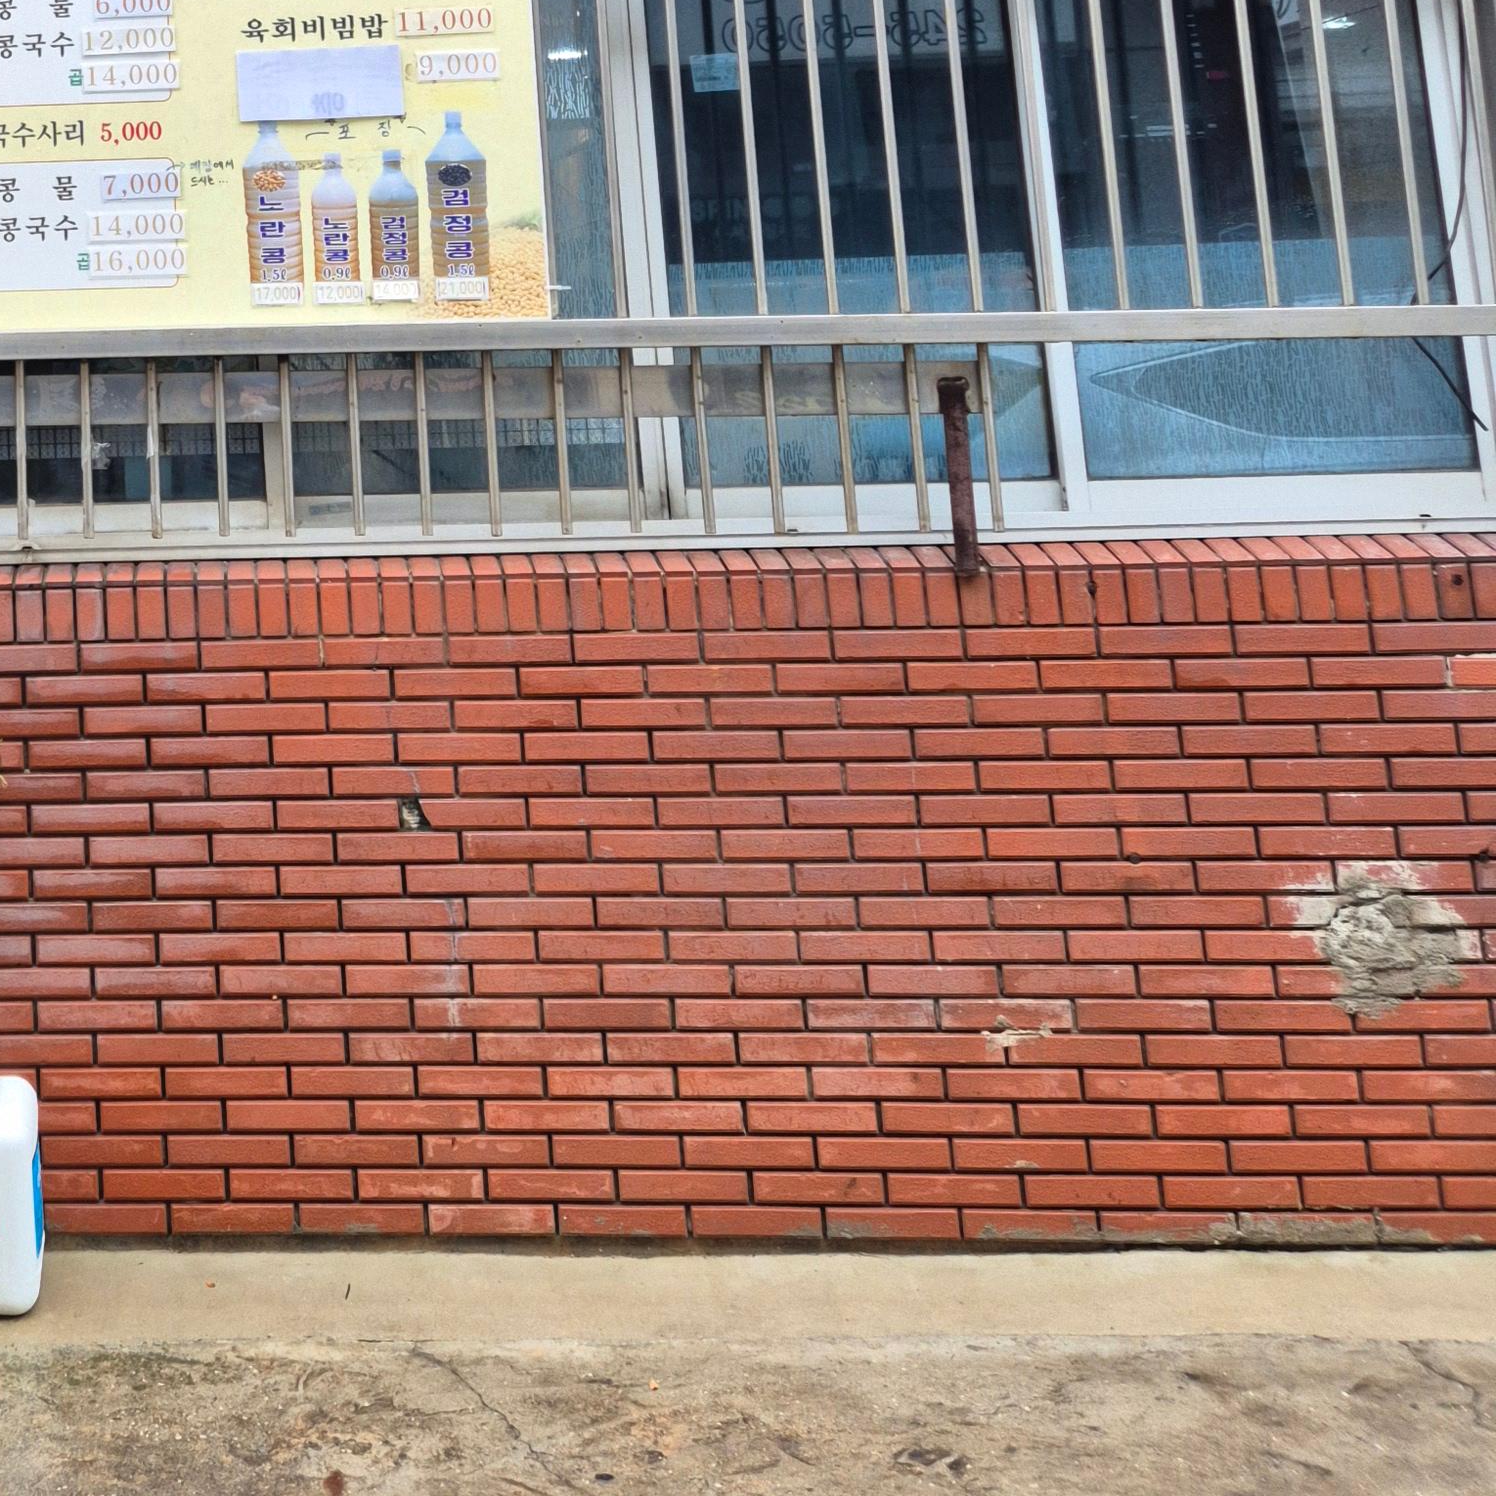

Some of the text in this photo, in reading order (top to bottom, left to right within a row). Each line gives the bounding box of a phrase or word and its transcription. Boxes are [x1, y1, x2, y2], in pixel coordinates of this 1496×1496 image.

[240, 7, 492, 42] 육회비빔밥 11,000
[83, 27, 175, 52] 12,000
[87, 63, 177, 88] 14,000
[419, 52, 497, 77] 9,000
[100, 121, 162, 146] 5,000
[103, 172, 179, 198] 7,000
[92, 213, 184, 238] 14,000
[258, 195, 287, 264] 노란콩
[441, 189, 474, 259] 검정콩
[322, 217, 350, 262] 노란콩
[381, 216, 409, 262] 검정콩
[93, 248, 185, 274] 16,000
